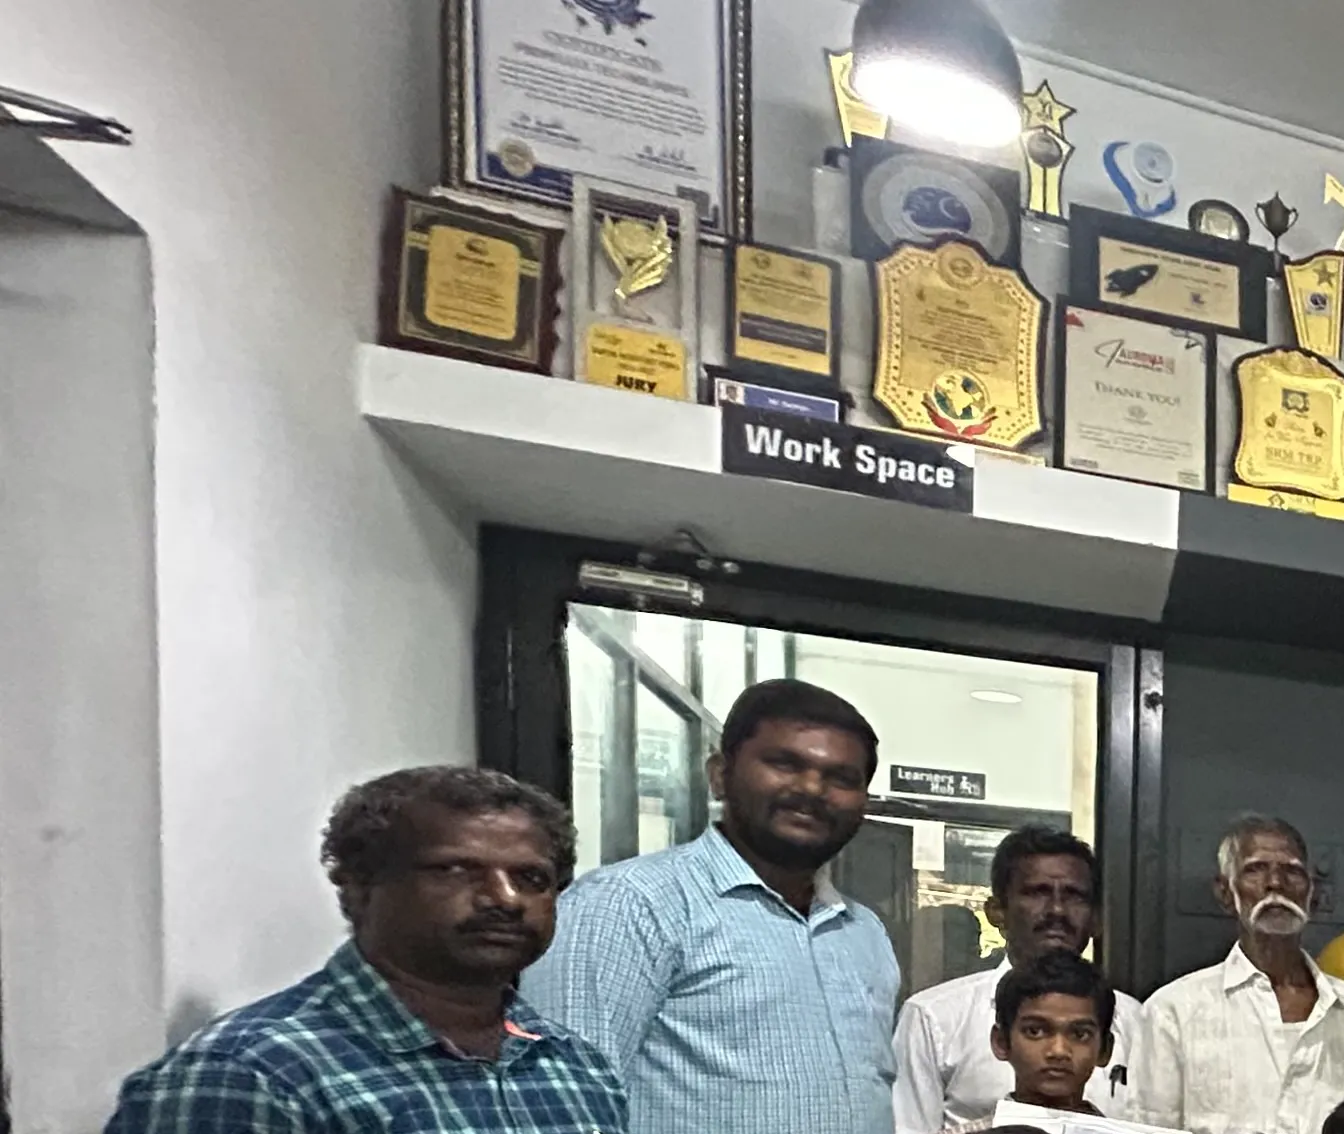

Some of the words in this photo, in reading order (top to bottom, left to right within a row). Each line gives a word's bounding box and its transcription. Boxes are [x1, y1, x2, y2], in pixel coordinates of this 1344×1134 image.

[616, 374, 657, 394] JURY
[745, 424, 842, 469] Work
[854, 445, 956, 489] Space
[897, 767, 954, 784] Learners
[930, 781, 955, 796] Hub
